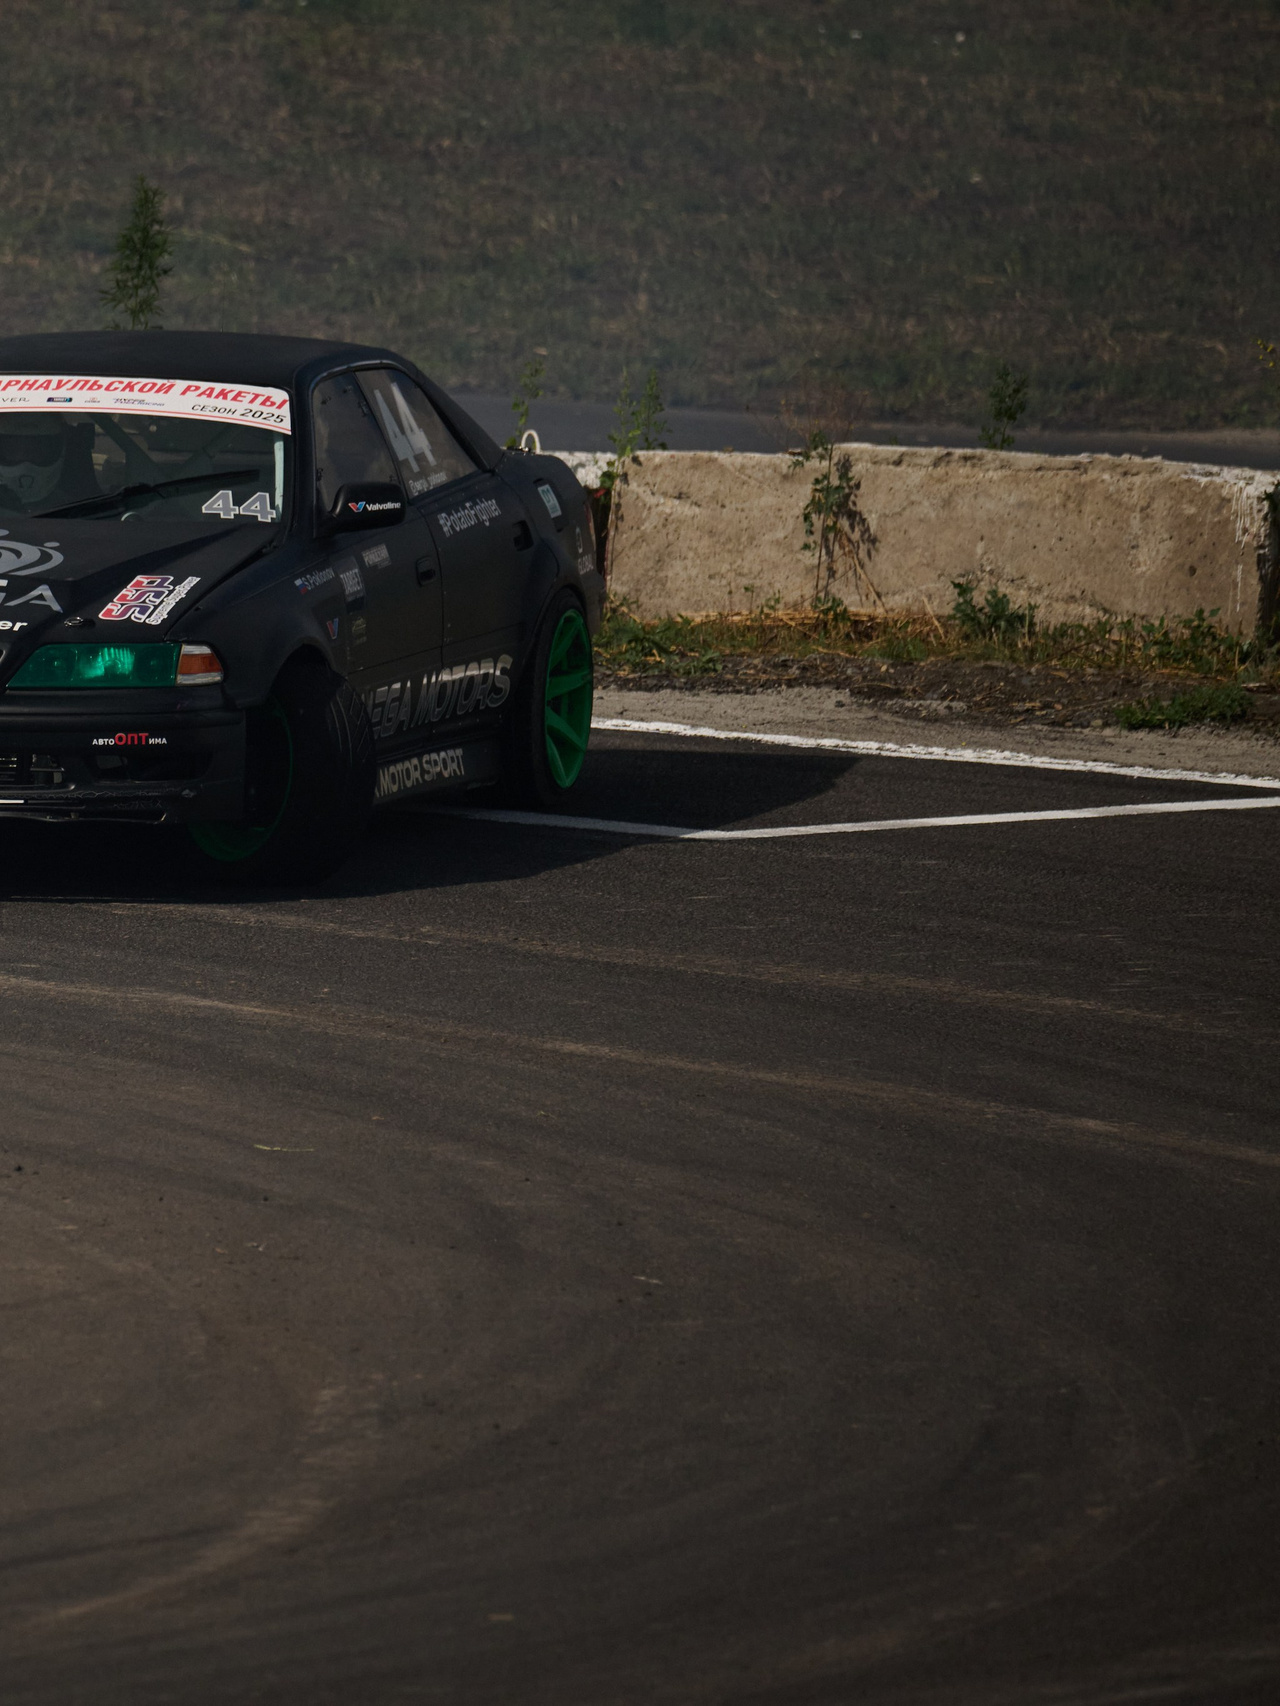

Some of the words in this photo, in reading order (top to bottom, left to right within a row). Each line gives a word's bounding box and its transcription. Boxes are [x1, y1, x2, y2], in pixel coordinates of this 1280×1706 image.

[180, 384, 290, 410] РАКЕТЫ
[191, 404, 238, 415] СЕЗОН
[239, 408, 287, 424] 2025
[373, 382, 437, 473] 44
[201, 490, 276, 523] 44
[366, 502, 402, 512] Valvoline
[437, 497, 502, 538] #PotatoFighter
[411, 653, 513, 729] MOTORS
[380, 757, 423, 796] MOTOR
[422, 747, 465, 782] SPORT
